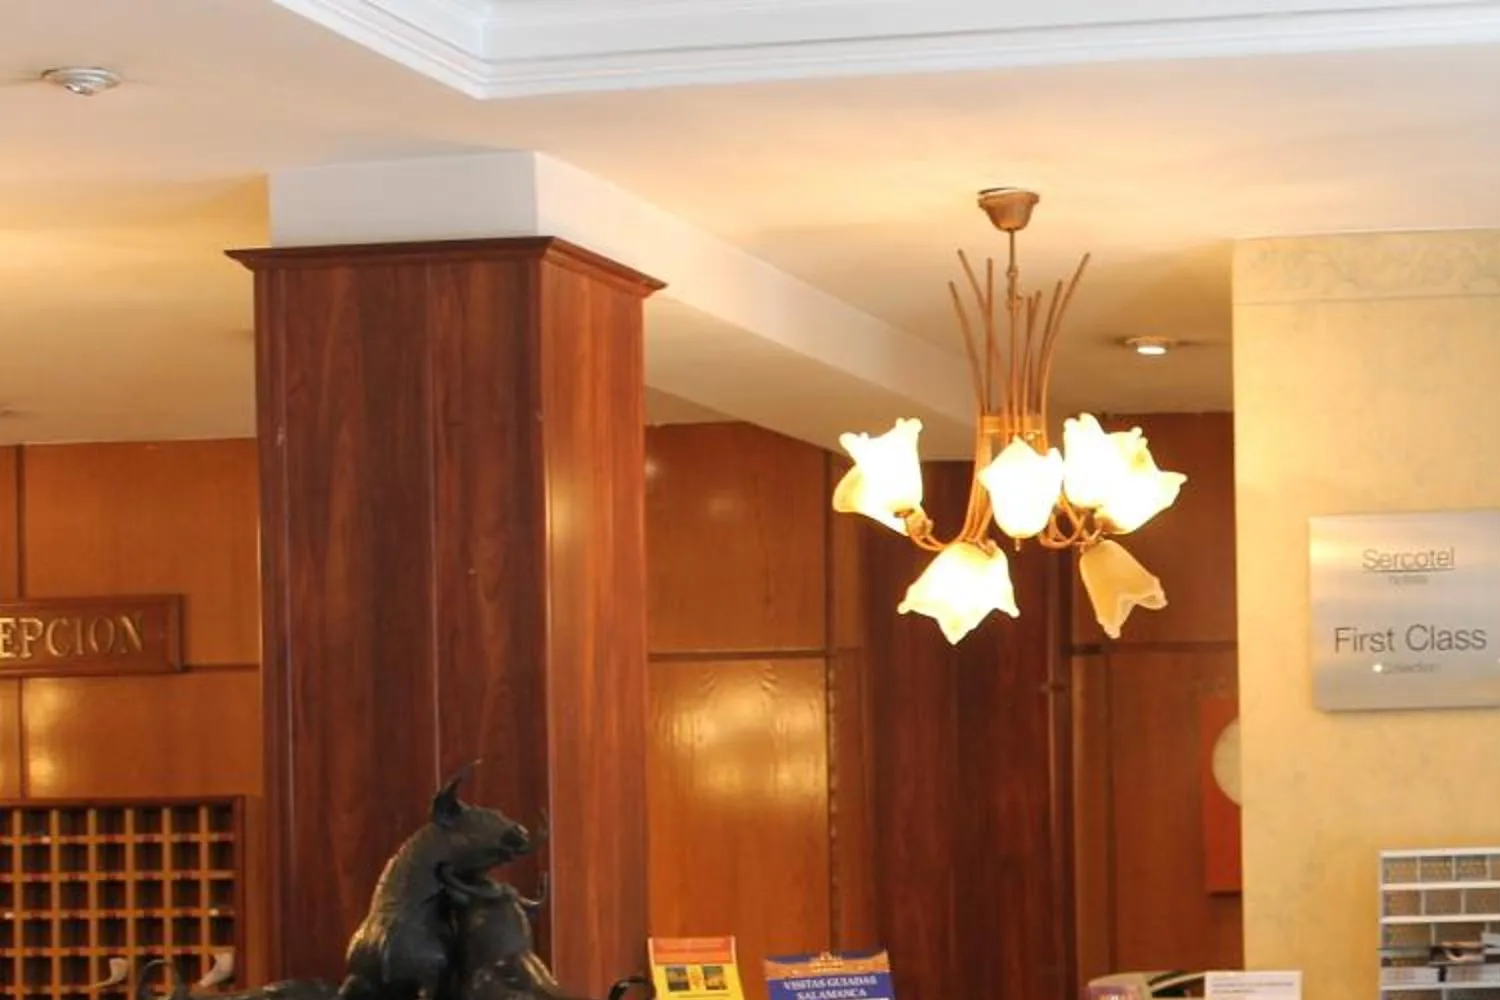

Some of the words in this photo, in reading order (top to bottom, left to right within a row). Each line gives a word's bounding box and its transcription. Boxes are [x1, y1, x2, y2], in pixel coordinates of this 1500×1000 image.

[1361, 547, 1455, 570] Sercotel
[1334, 626, 1395, 653] First
[1405, 623, 1488, 651] Class
